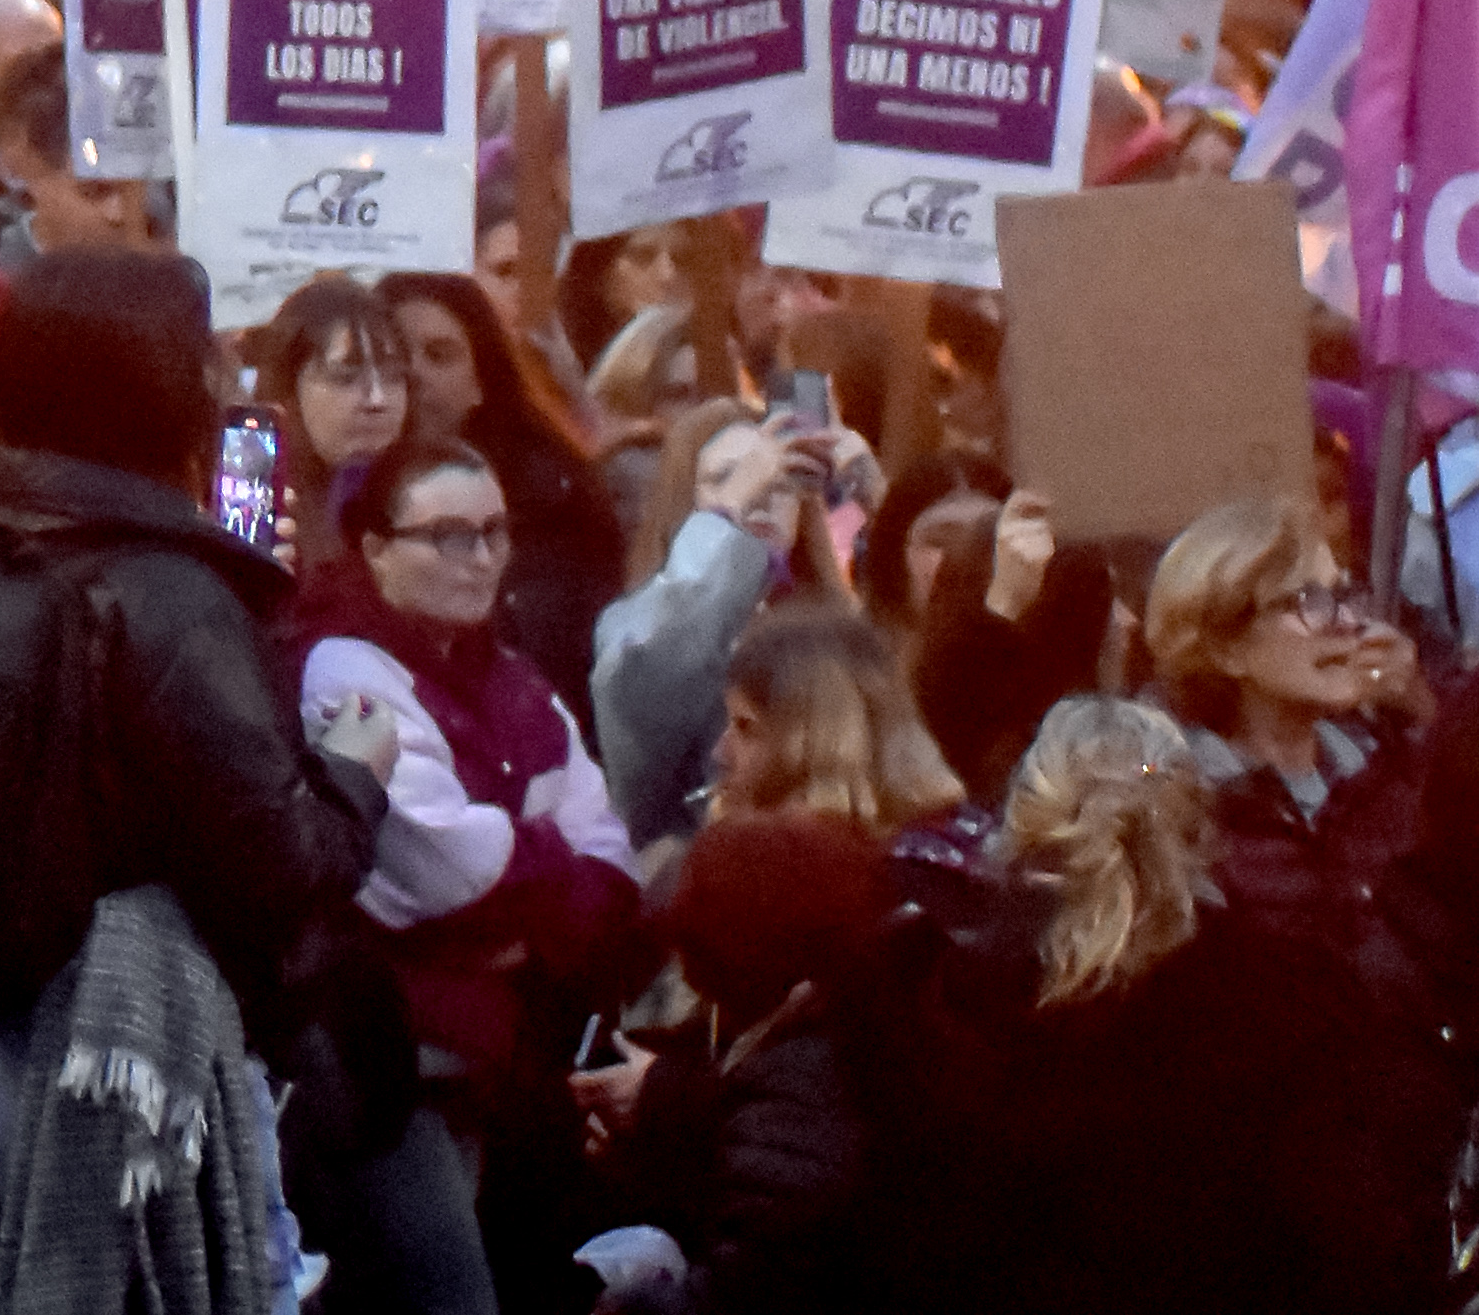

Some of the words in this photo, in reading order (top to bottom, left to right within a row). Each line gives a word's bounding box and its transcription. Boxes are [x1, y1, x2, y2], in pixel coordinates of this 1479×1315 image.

[288, 1, 373, 38] TODOS
[1008, 14, 1043, 57] NI
[266, 42, 314, 82] LOS
[617, 23, 650, 62] DE
[845, 42, 909, 90] UNA
[917, 51, 1031, 106] MENOS
[904, 204, 973, 238] SEC
